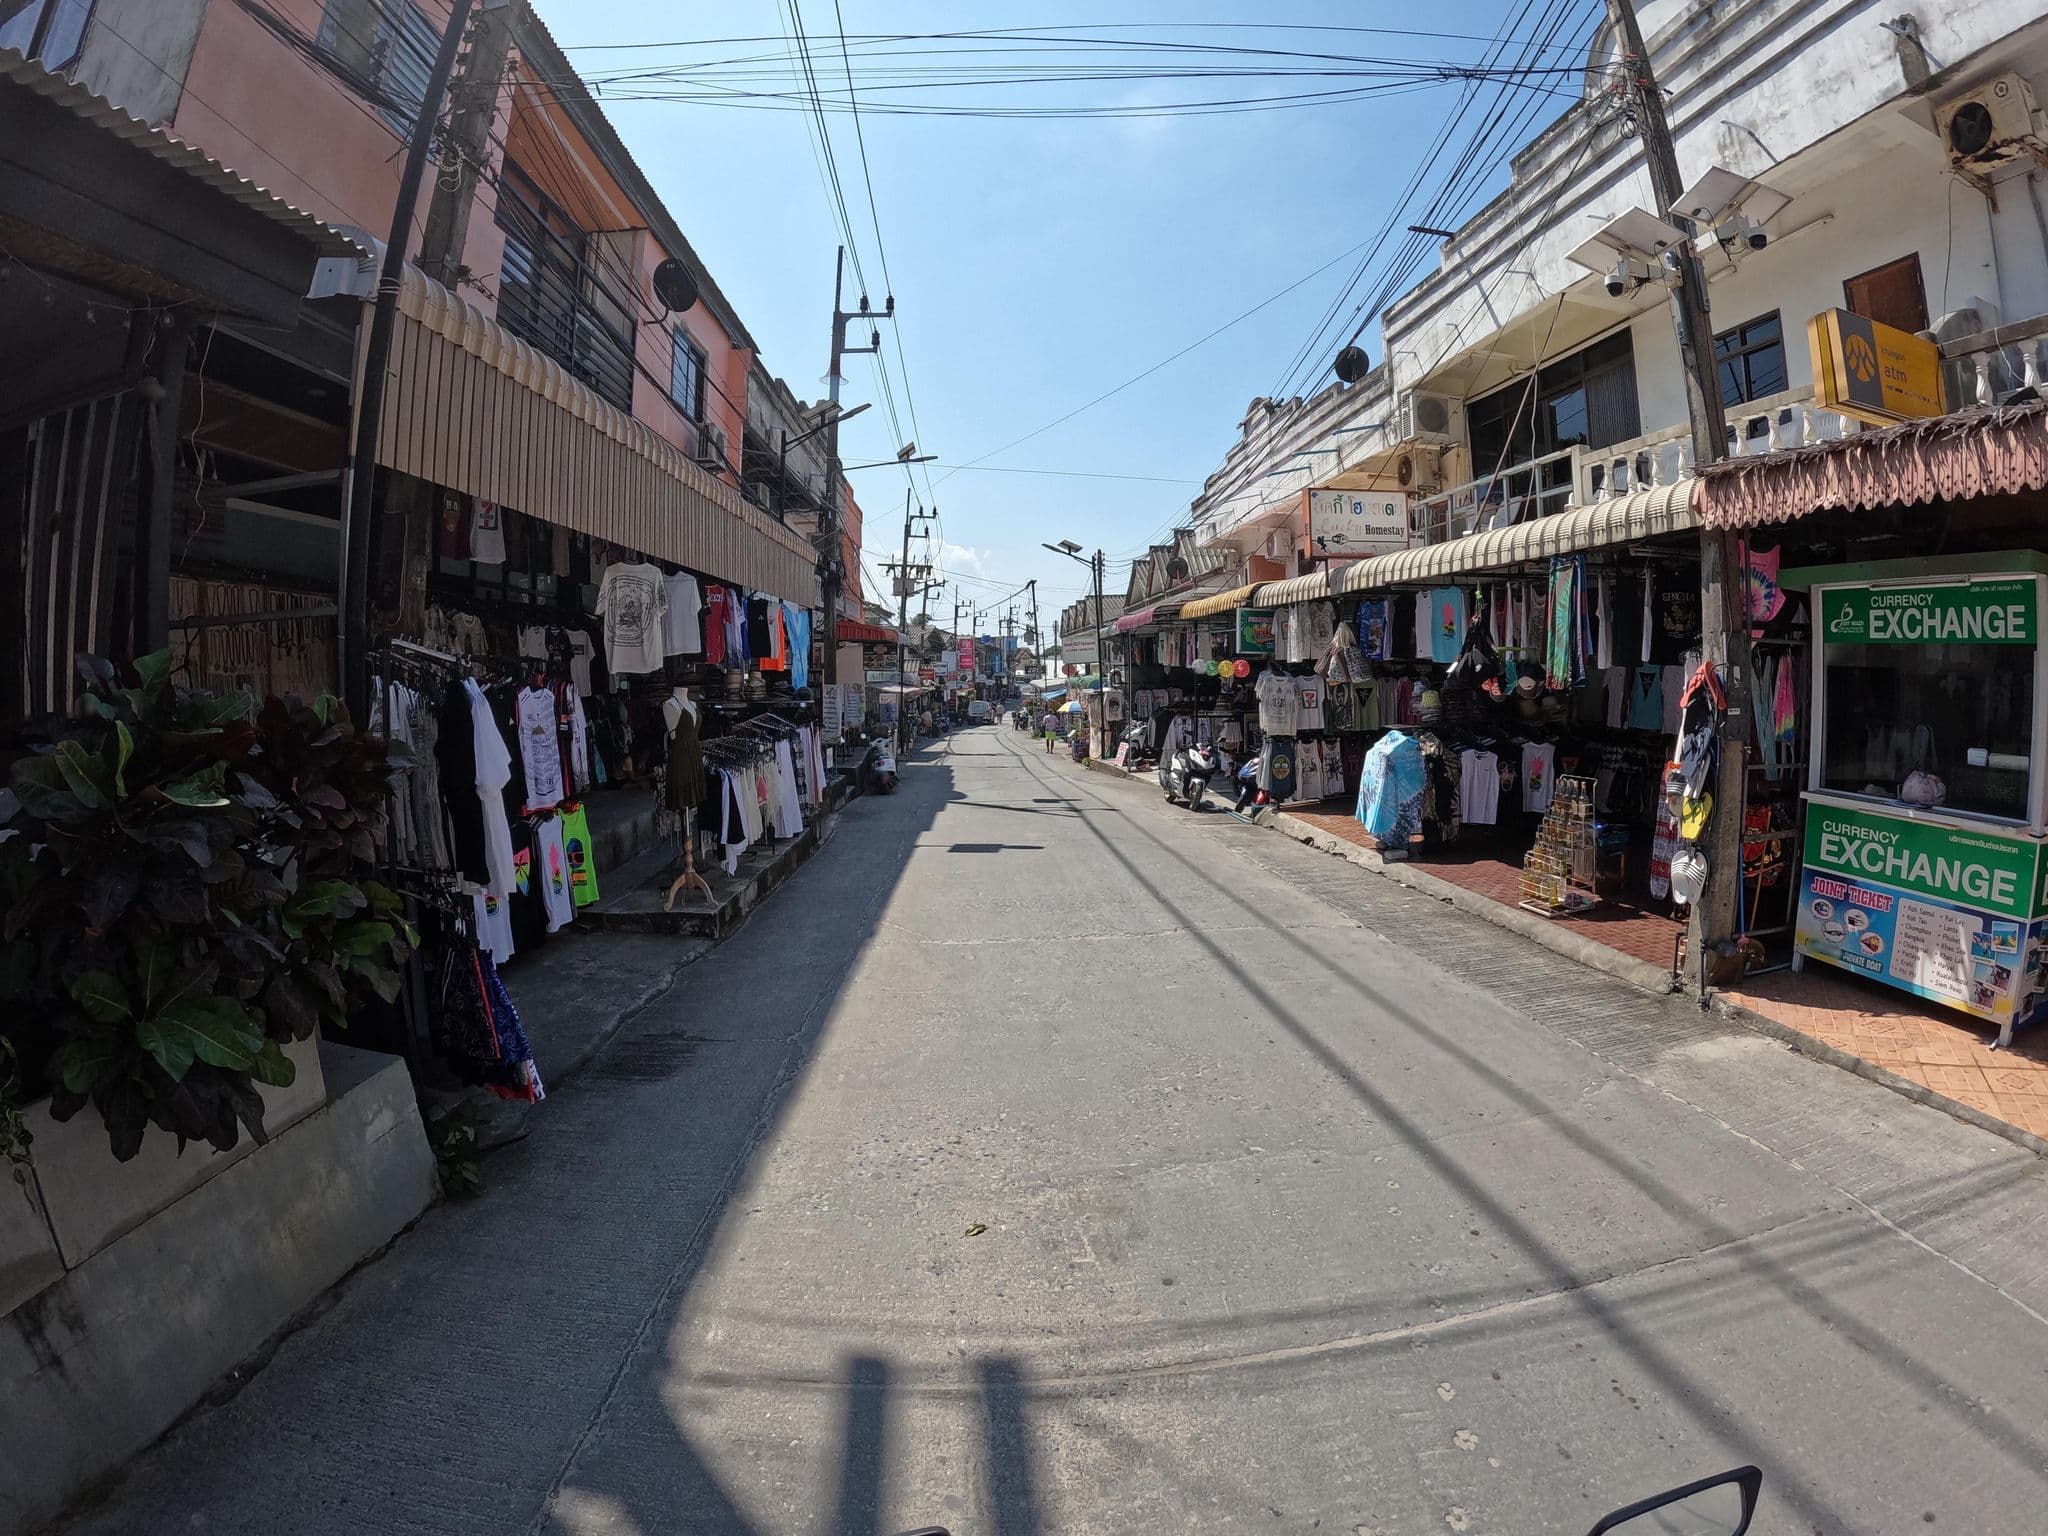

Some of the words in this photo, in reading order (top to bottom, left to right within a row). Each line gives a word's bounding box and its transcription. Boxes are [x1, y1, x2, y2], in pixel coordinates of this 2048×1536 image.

[1885, 365, 1908, 383] atm
[1365, 524, 1405, 538] Homestay
[1870, 593, 1934, 608] CURRENCY
[1869, 604, 2026, 639] EXCHANGE
[1822, 820, 1900, 845] CURRENCY
[1819, 833, 2018, 906] EXCHANGE
[1811, 877, 1847, 900] JOINT
[1848, 884, 1894, 913] TICKET
[1904, 932, 1926, 944] Bangkok
[1842, 950, 1866, 967] PRIVATE
[1866, 957, 1882, 972] BOAT
